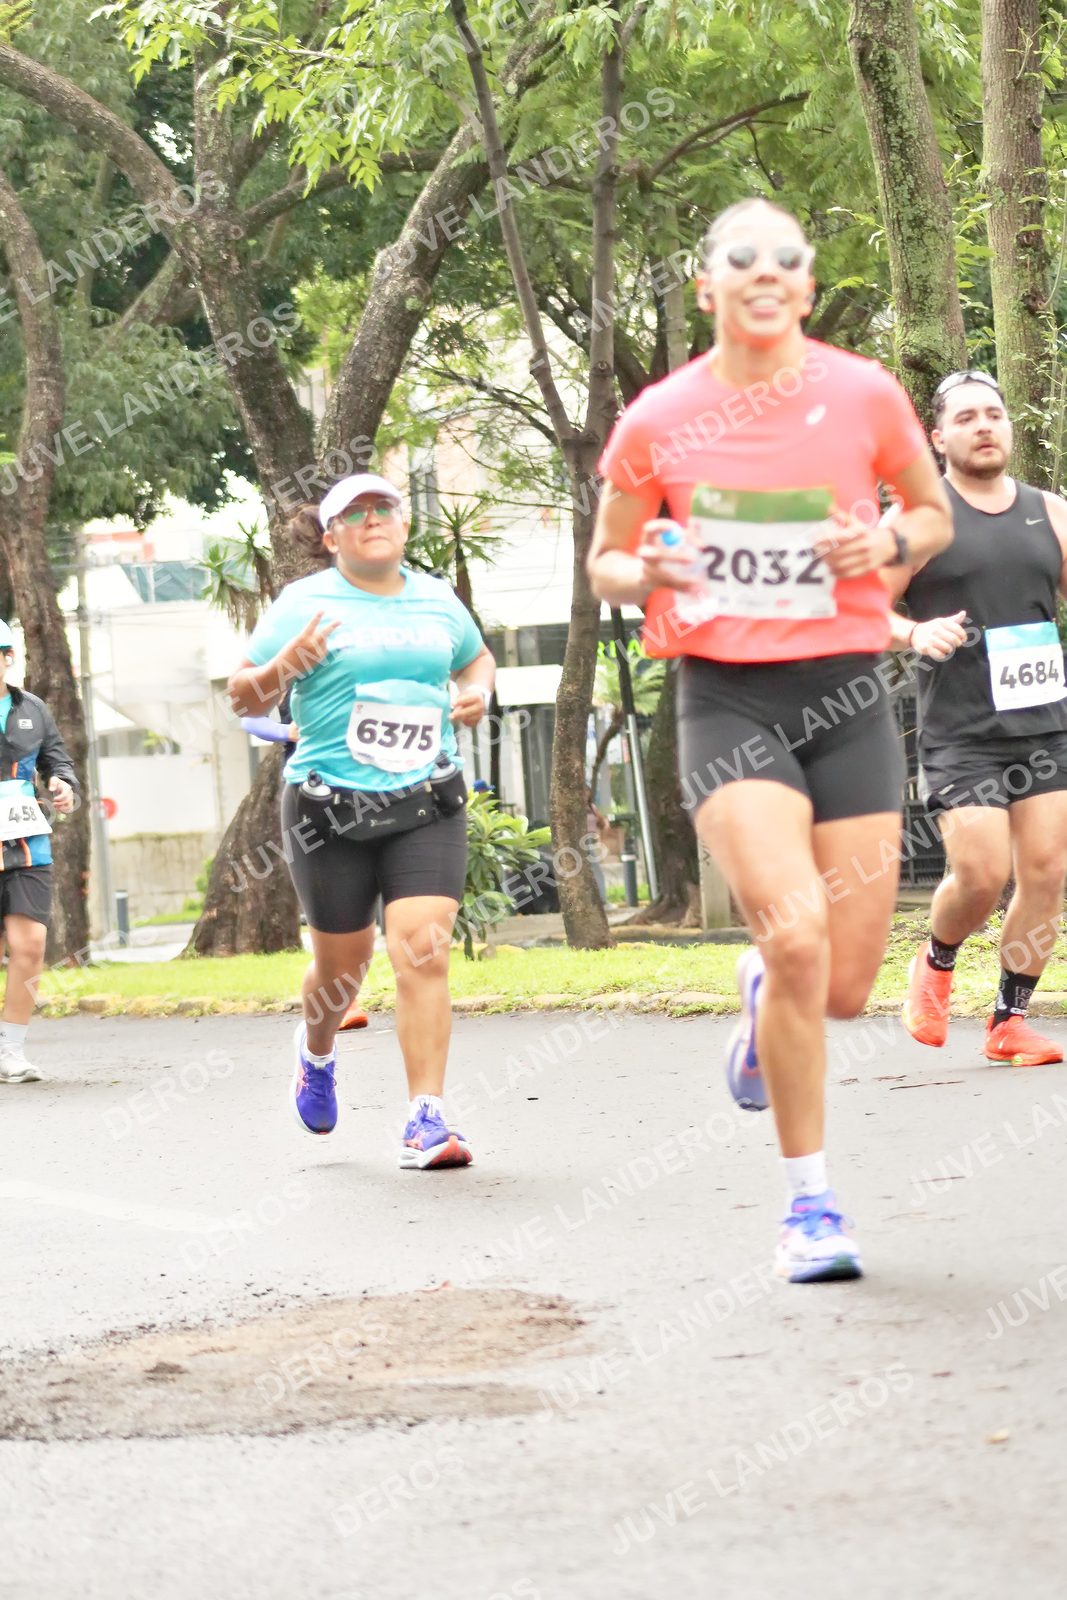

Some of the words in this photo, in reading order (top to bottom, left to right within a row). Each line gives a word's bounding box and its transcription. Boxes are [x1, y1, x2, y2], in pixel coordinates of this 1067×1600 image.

[701, 545, 825, 587] 2032
[1000, 659, 1059, 689] 4684
[357, 718, 434, 751] 6375
